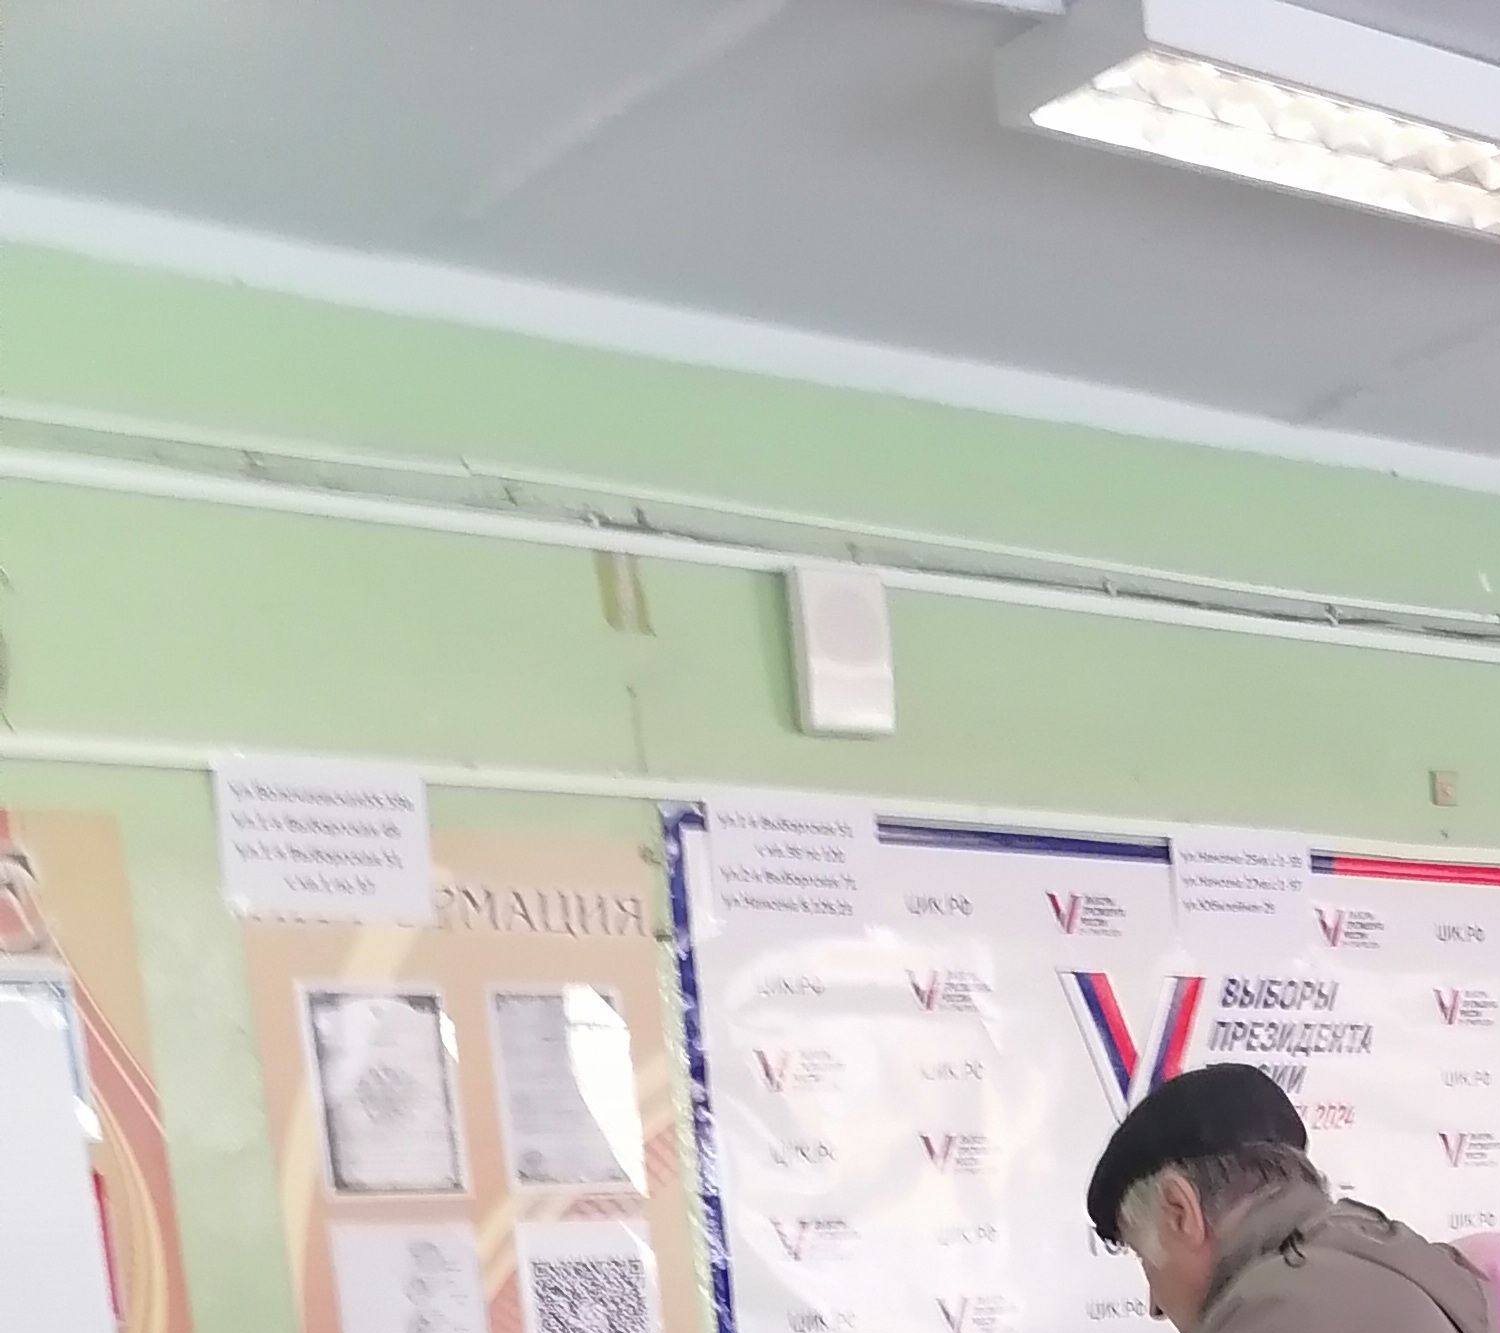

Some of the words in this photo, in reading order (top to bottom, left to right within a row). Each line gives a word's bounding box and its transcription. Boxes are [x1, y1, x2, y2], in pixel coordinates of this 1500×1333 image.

[1220, 977, 1340, 1011] ВЫБОРЫ
[1208, 1021, 1374, 1057] ПРЕЗИДЕНТА
[1313, 1104, 1355, 1130] 2024
